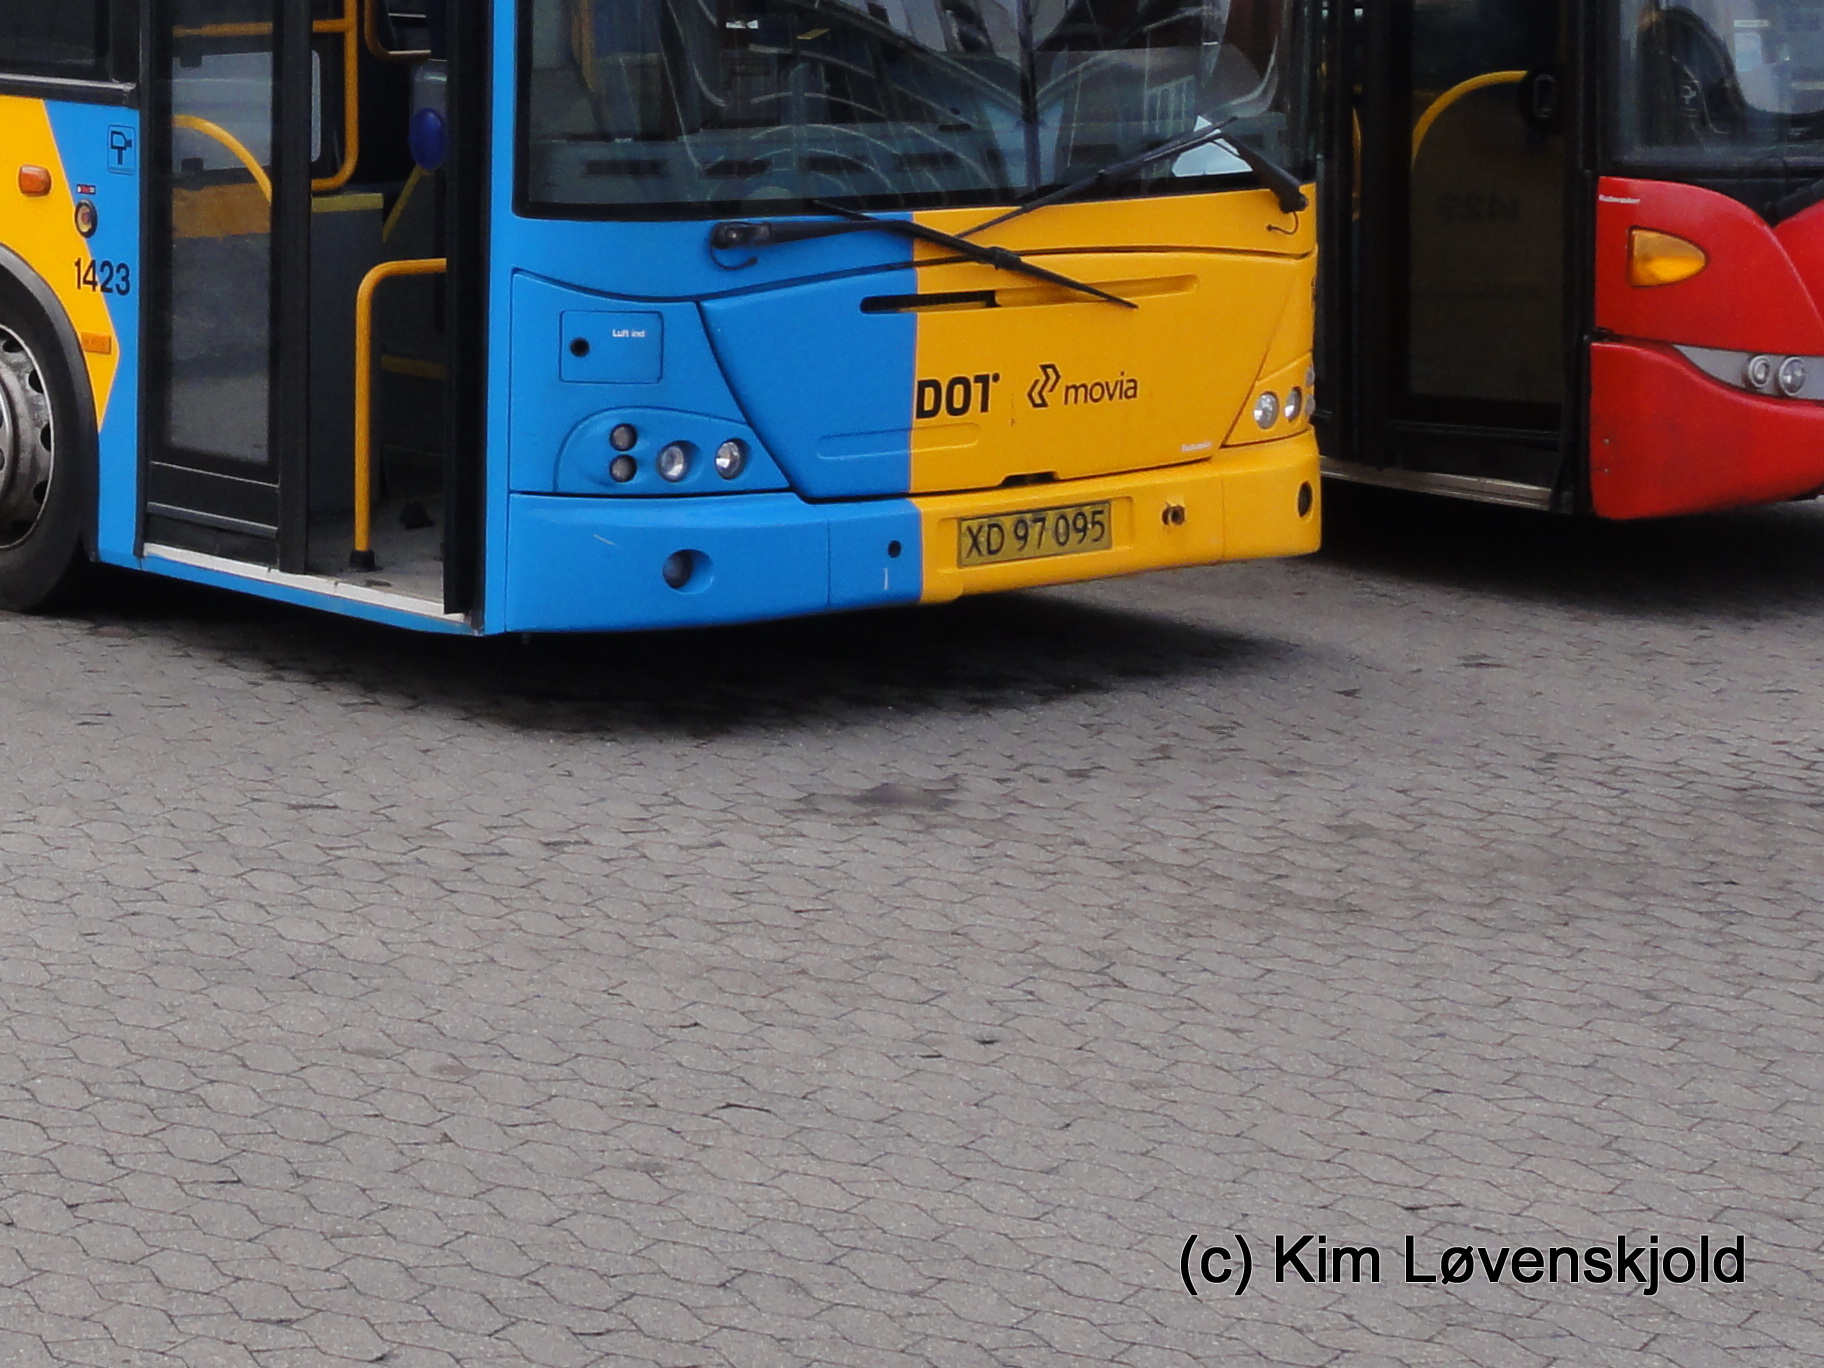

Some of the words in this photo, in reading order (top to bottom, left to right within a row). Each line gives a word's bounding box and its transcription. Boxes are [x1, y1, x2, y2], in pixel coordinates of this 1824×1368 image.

[74, 257, 131, 296] 1423
[916, 372, 1000, 419] DOT
[1063, 370, 1138, 406] movia
[966, 522, 1005, 559] XD
